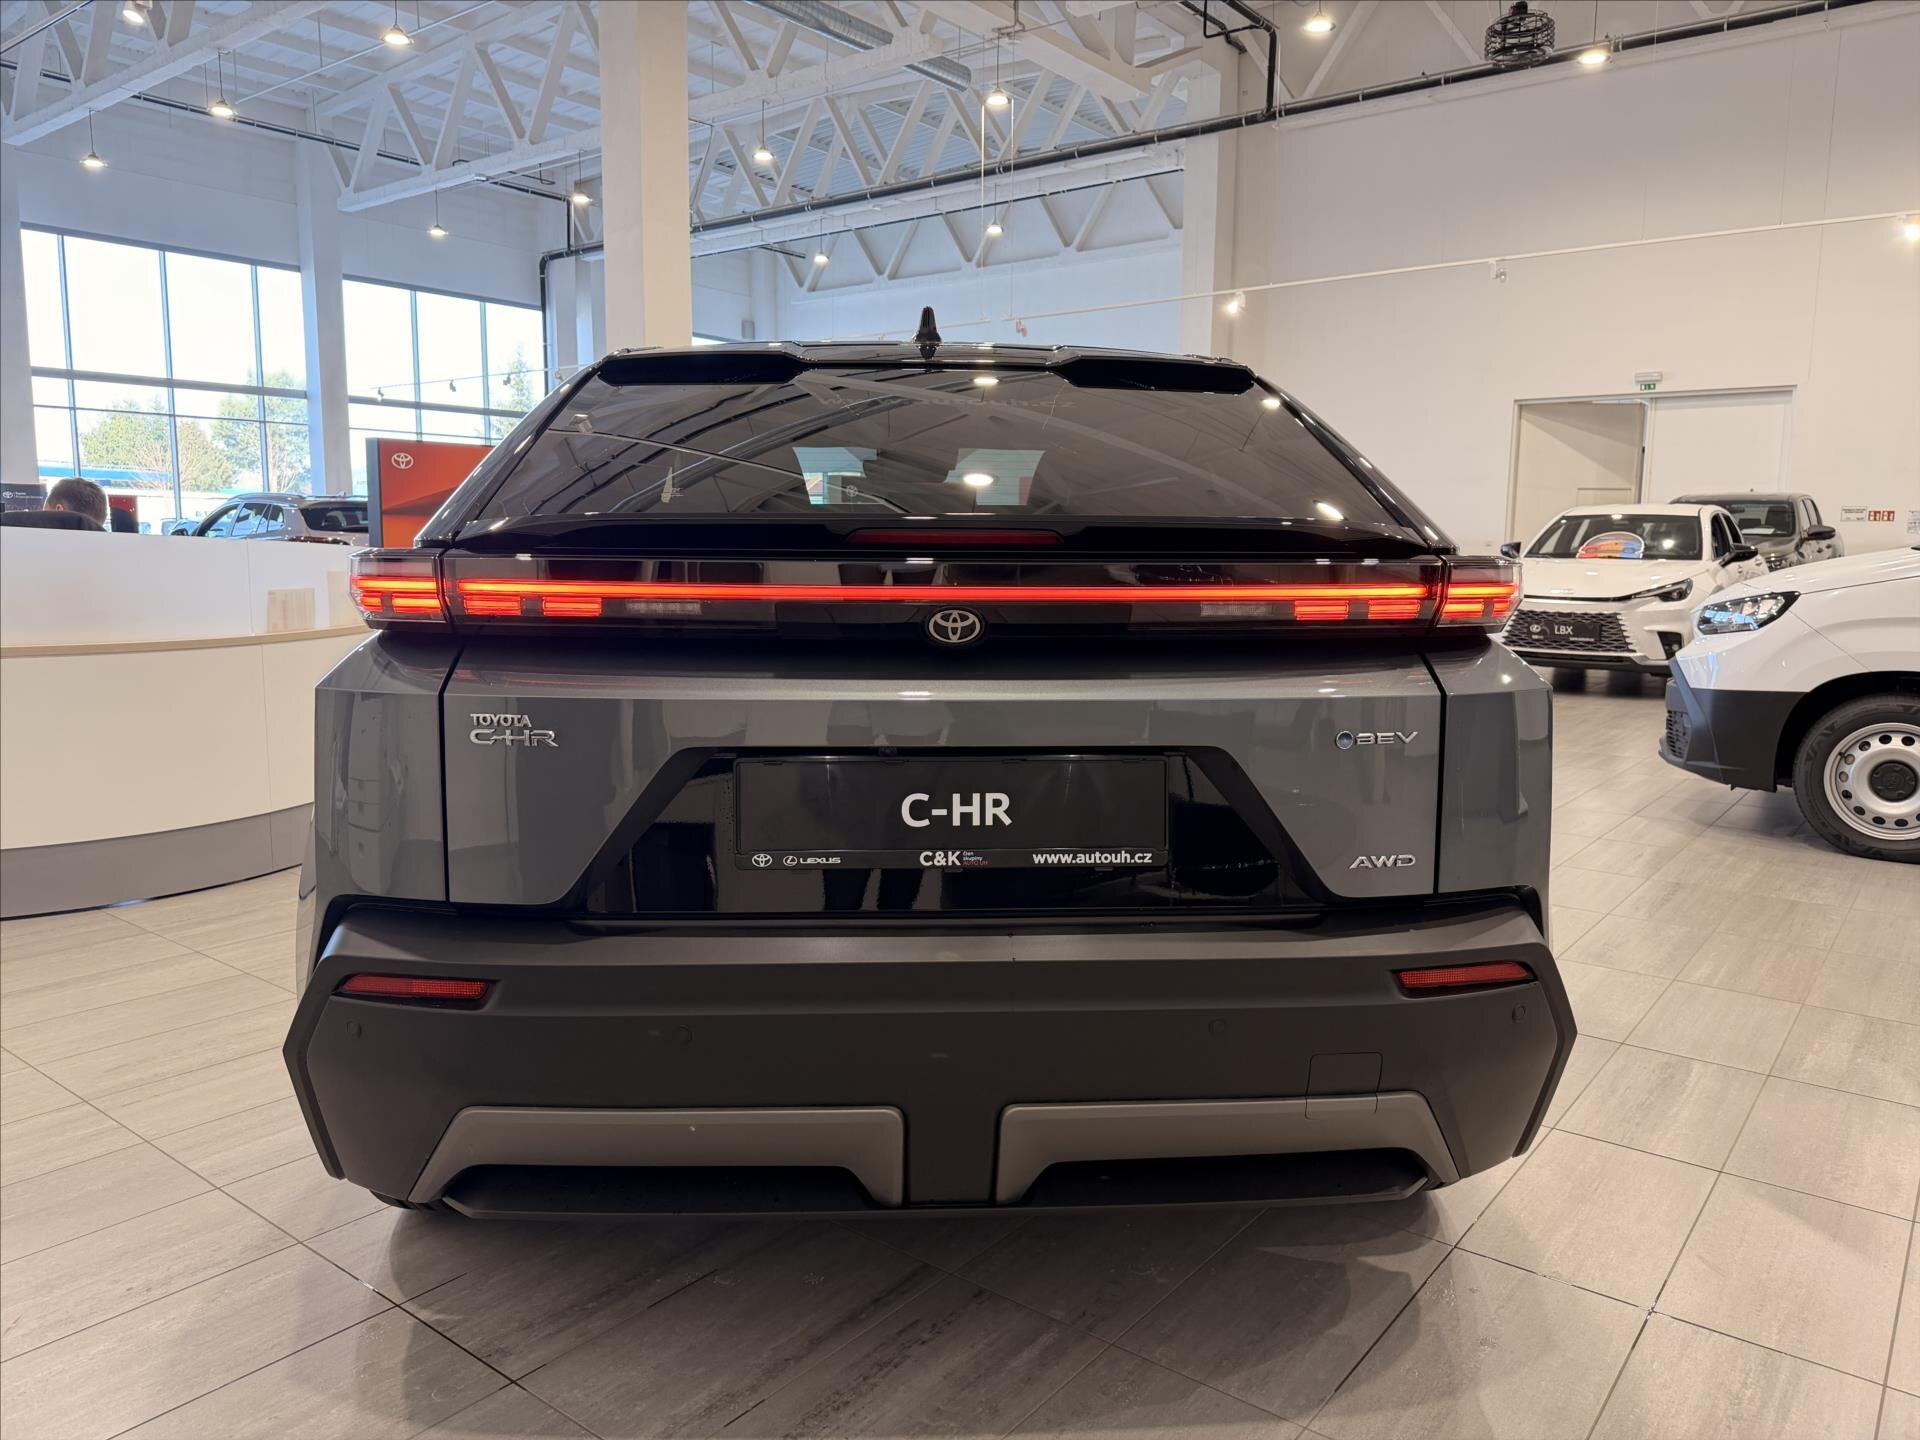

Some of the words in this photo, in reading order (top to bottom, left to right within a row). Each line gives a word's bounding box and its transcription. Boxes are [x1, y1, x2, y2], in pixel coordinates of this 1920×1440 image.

[1554, 625, 1573, 635] LBX
[470, 713, 532, 727] TOYOTA
[1356, 731, 1418, 745] BEV
[901, 793, 1013, 828] C-HR
[920, 851, 961, 866] C&K
[1032, 850, 1153, 864] www.autouh.cz
[1349, 854, 1416, 869] AWD
